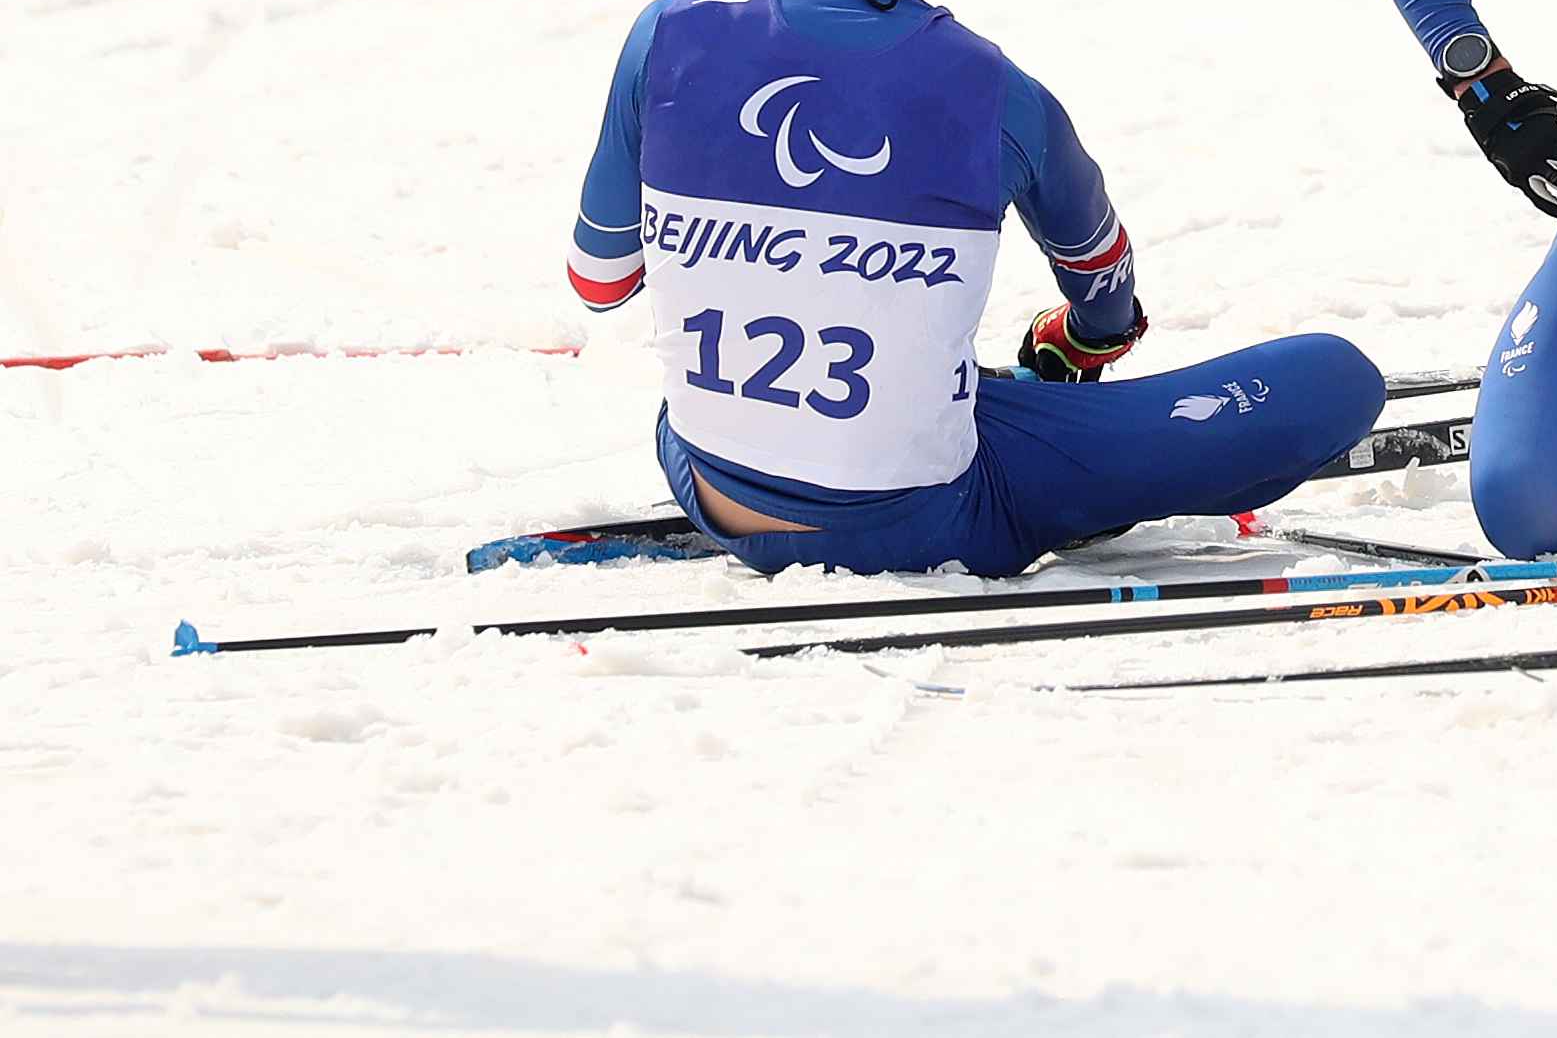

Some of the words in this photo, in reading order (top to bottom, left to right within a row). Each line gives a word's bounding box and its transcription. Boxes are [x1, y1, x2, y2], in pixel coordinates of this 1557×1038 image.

[643, 202, 806, 273] BEIJING
[819, 234, 965, 289] 2022
[682, 307, 875, 421] 123
